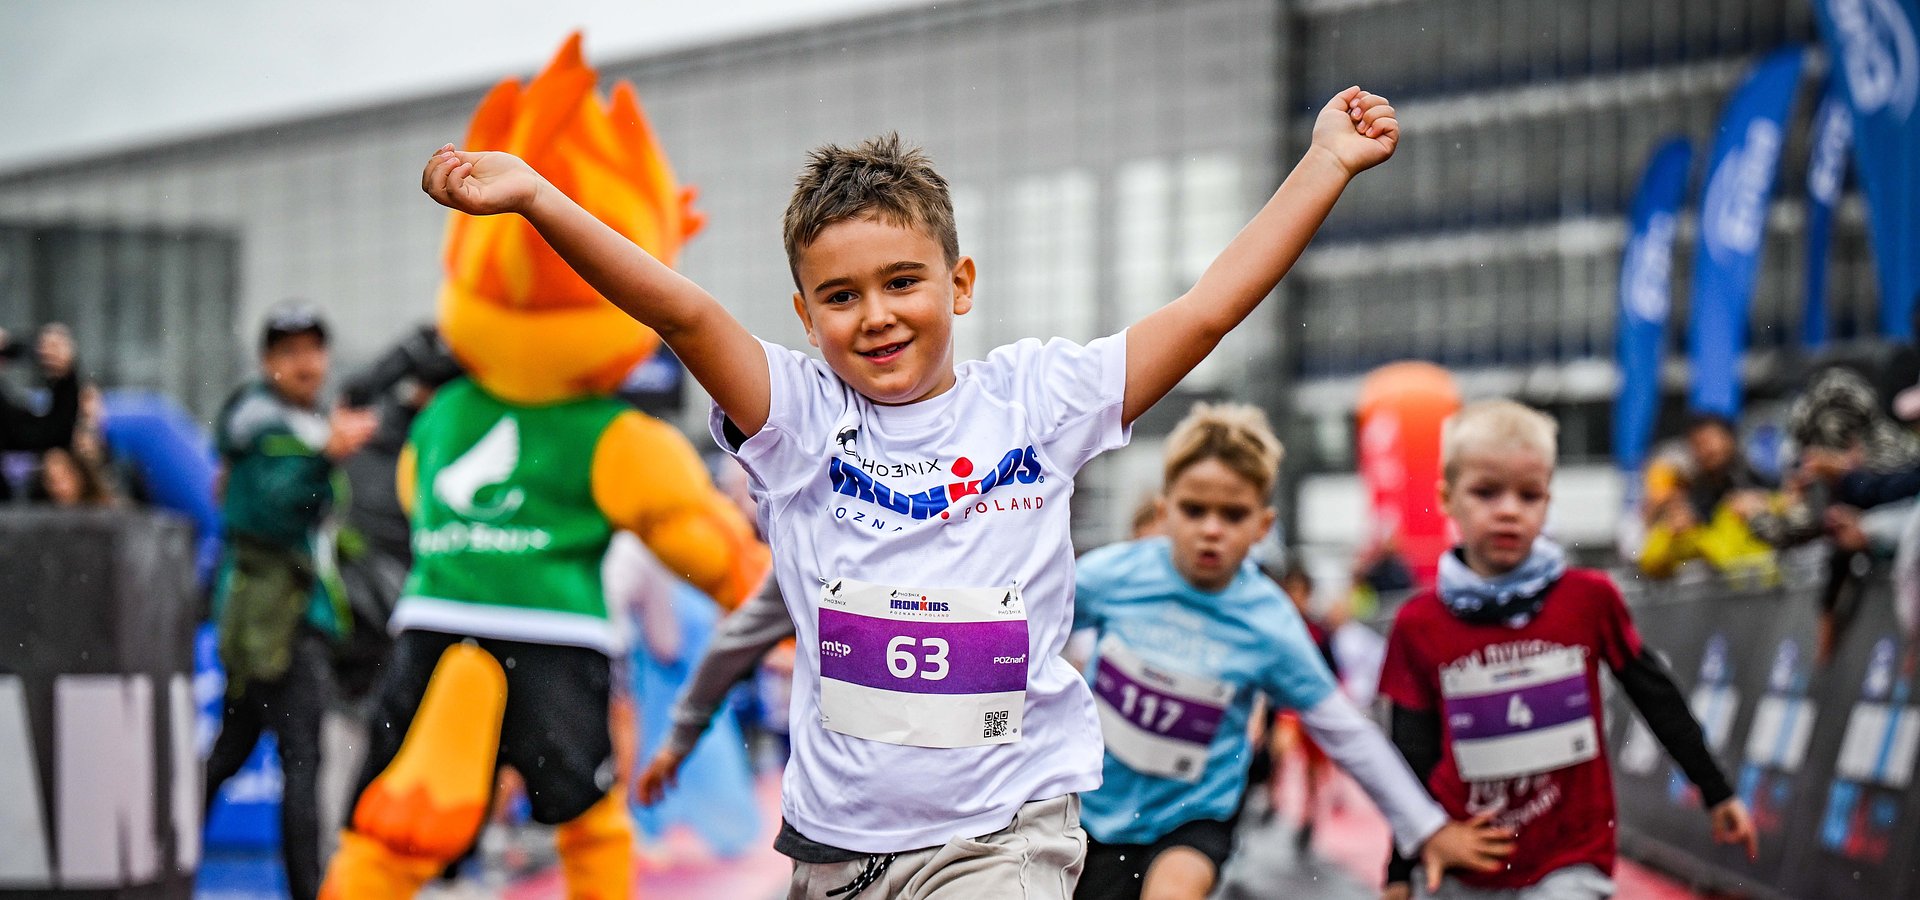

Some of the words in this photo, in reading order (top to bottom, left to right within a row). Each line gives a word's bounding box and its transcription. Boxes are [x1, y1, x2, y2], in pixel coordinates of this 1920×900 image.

[861, 458, 942, 478] HO3NIX
[964, 497, 1044, 519] POLAND
[821, 640, 852, 657] mtp
[886, 636, 950, 681] 63
[1121, 683, 1183, 733] 117
[1506, 693, 1534, 729] 4
